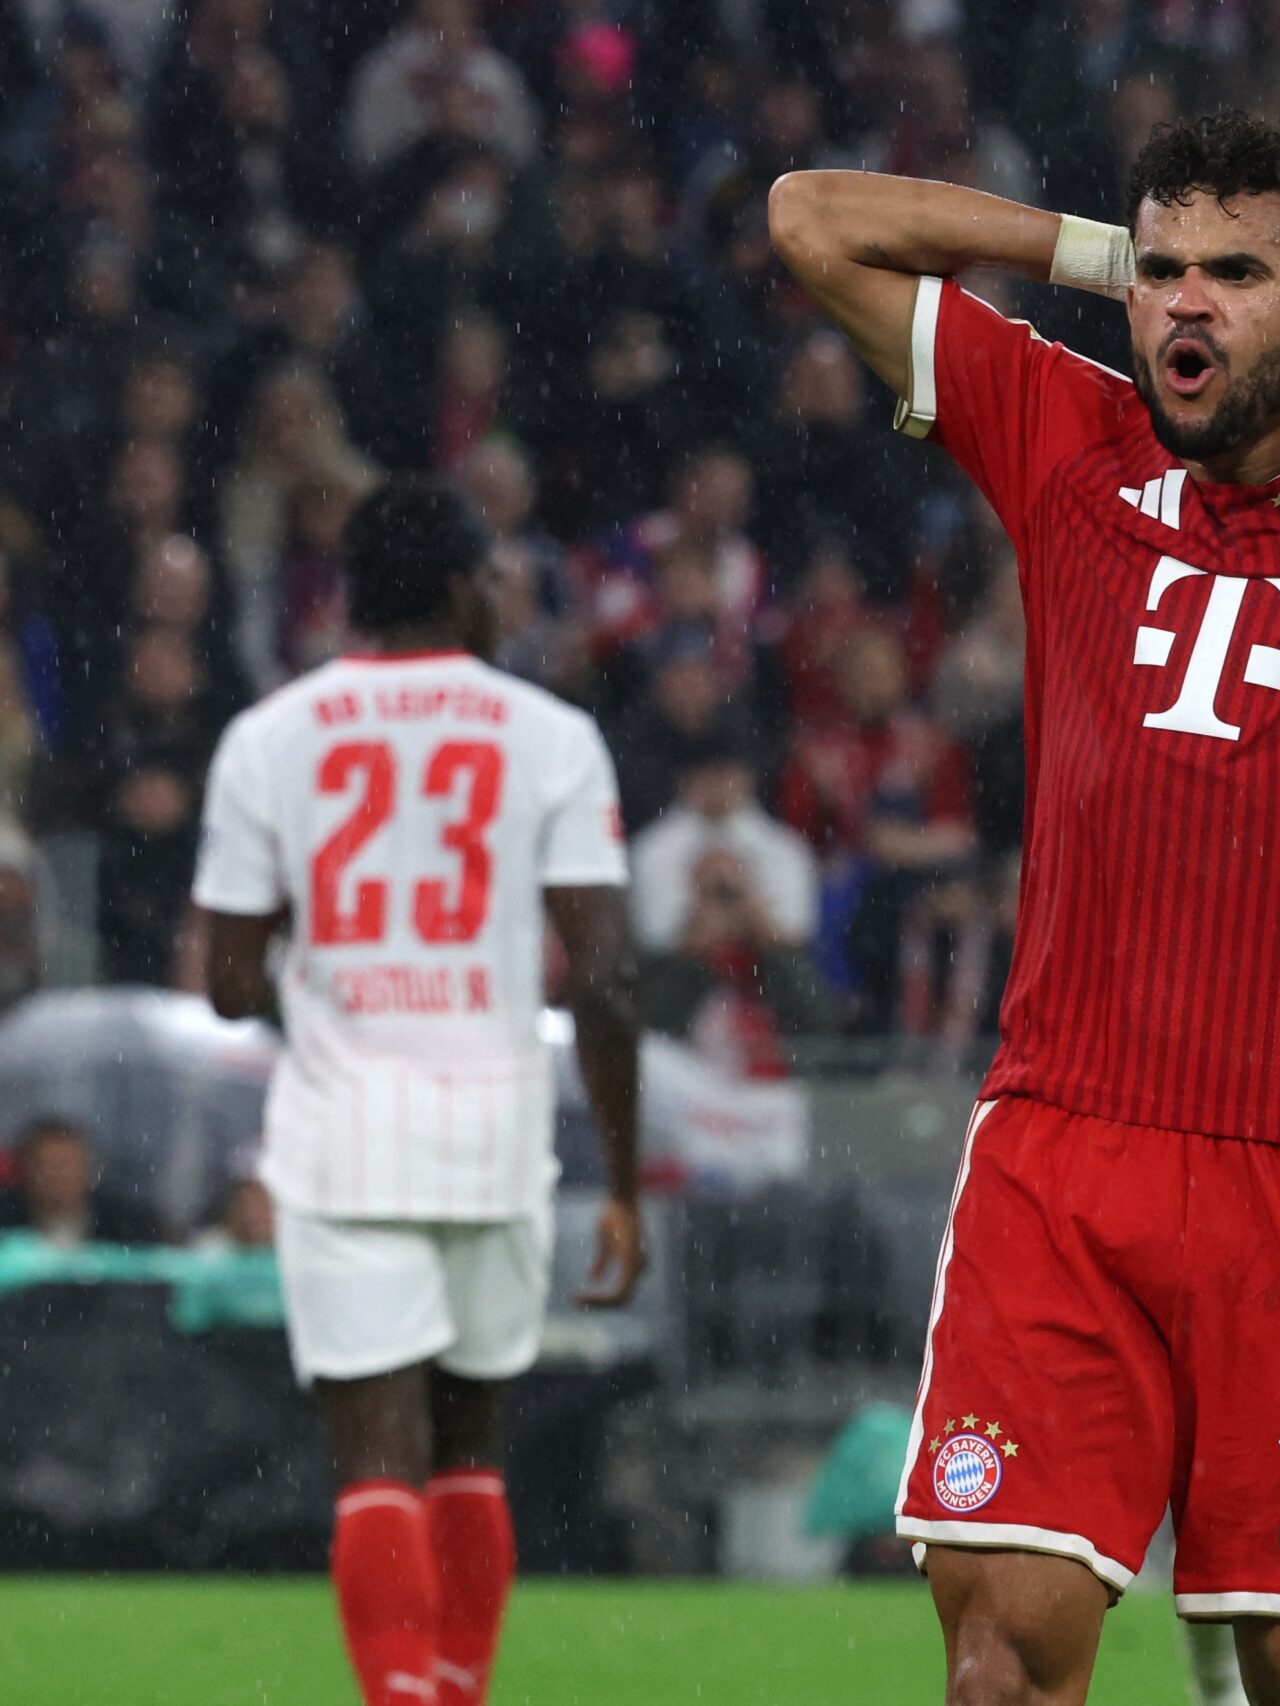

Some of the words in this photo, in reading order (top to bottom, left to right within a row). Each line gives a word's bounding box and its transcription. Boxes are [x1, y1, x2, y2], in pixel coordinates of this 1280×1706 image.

[310, 740, 508, 945] 23
[938, 1450, 951, 1468] FC
[951, 1440, 995, 1469] BAYERN
